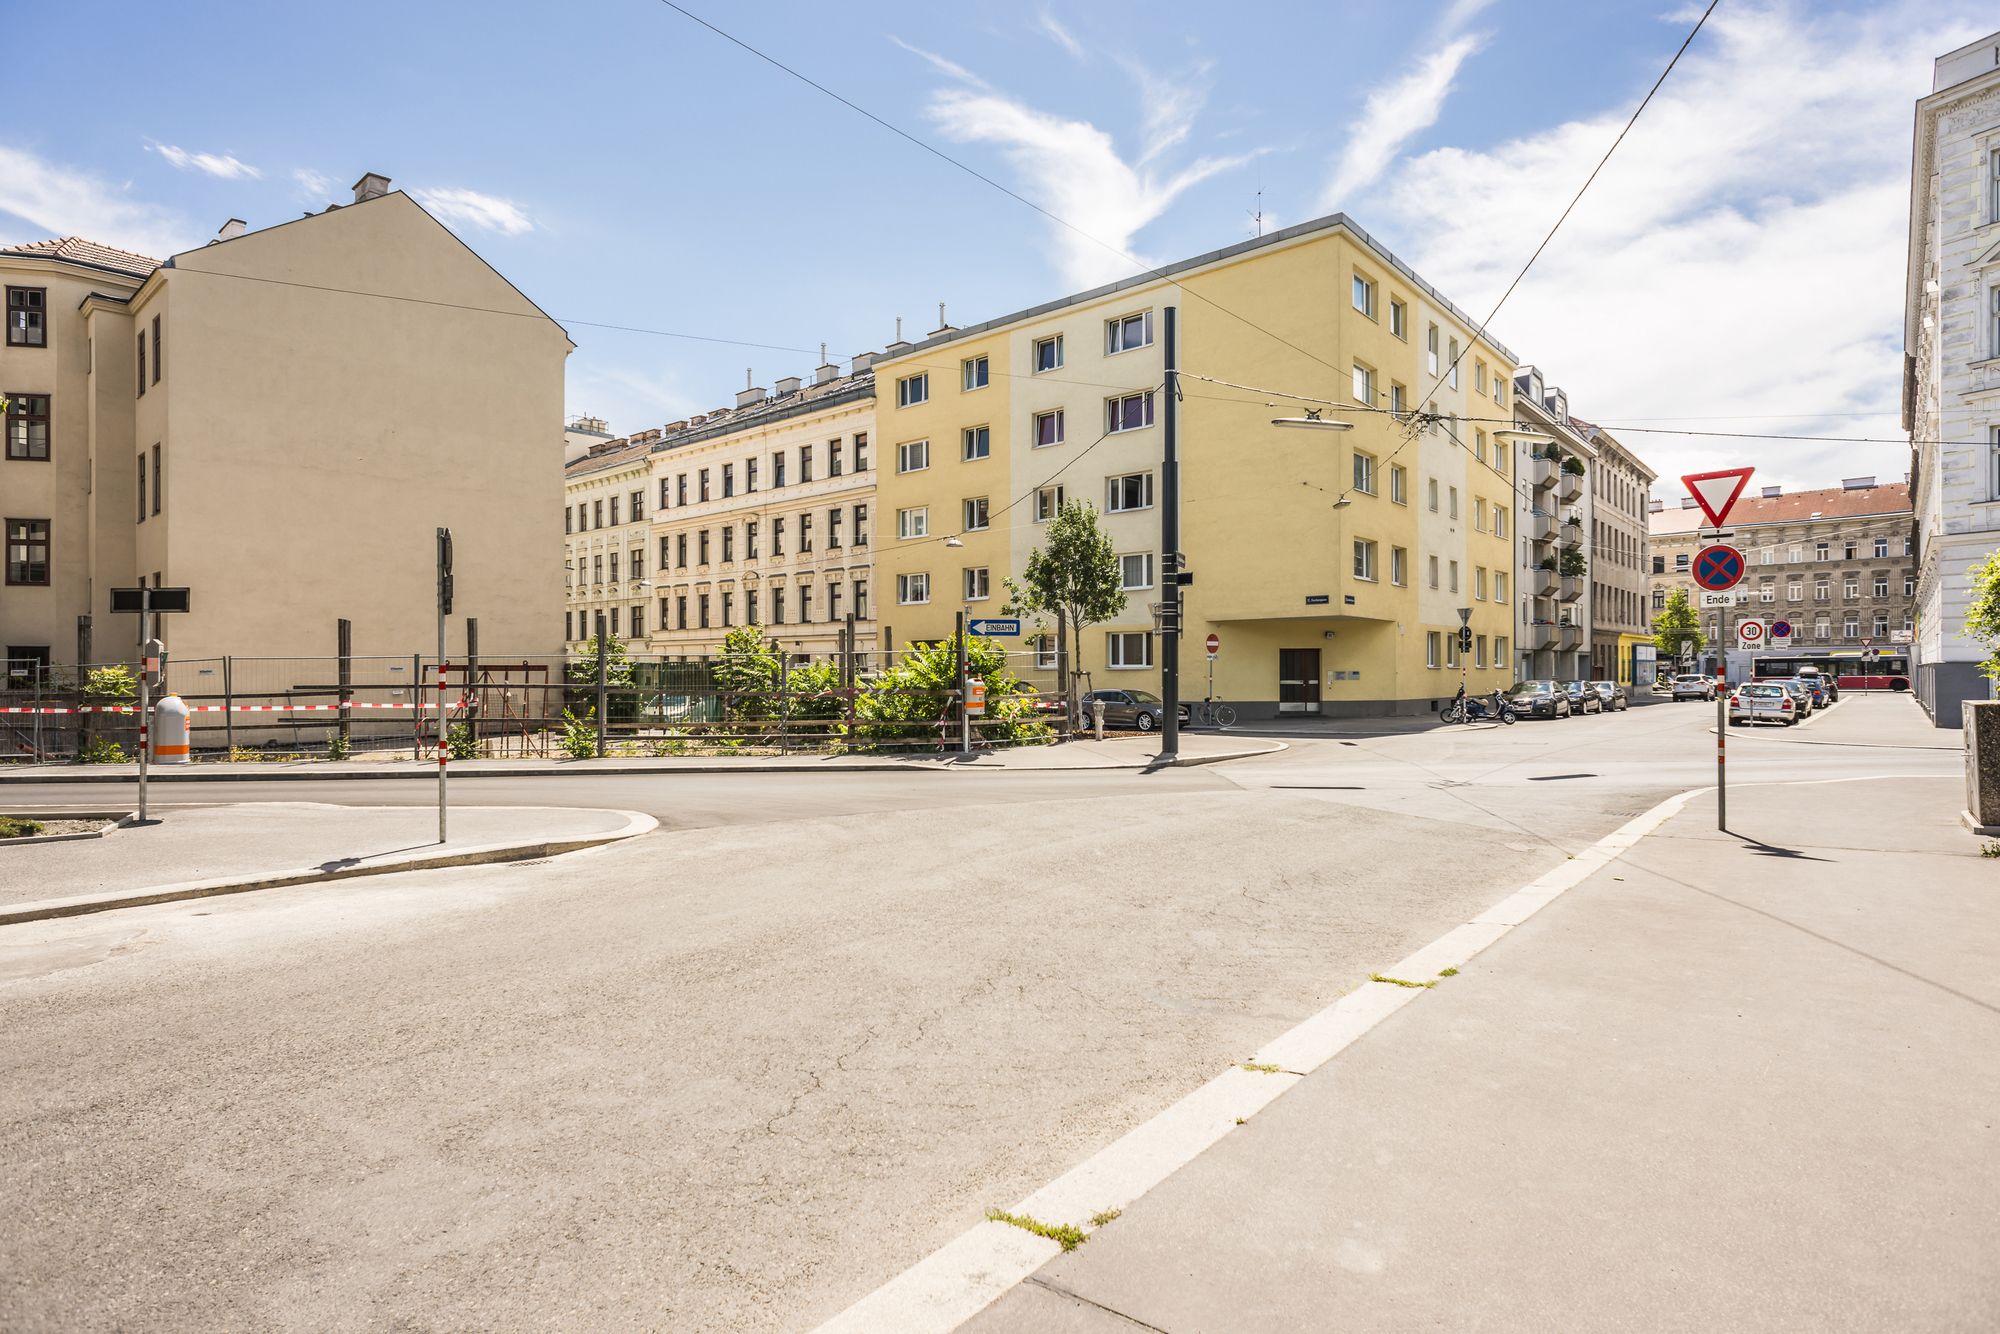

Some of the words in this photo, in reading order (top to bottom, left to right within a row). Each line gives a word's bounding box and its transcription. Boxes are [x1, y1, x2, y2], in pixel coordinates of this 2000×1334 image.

[1706, 595, 1730, 604] Ende
[1746, 627, 1757, 635] 30
[1742, 642, 1761, 650] Zone
